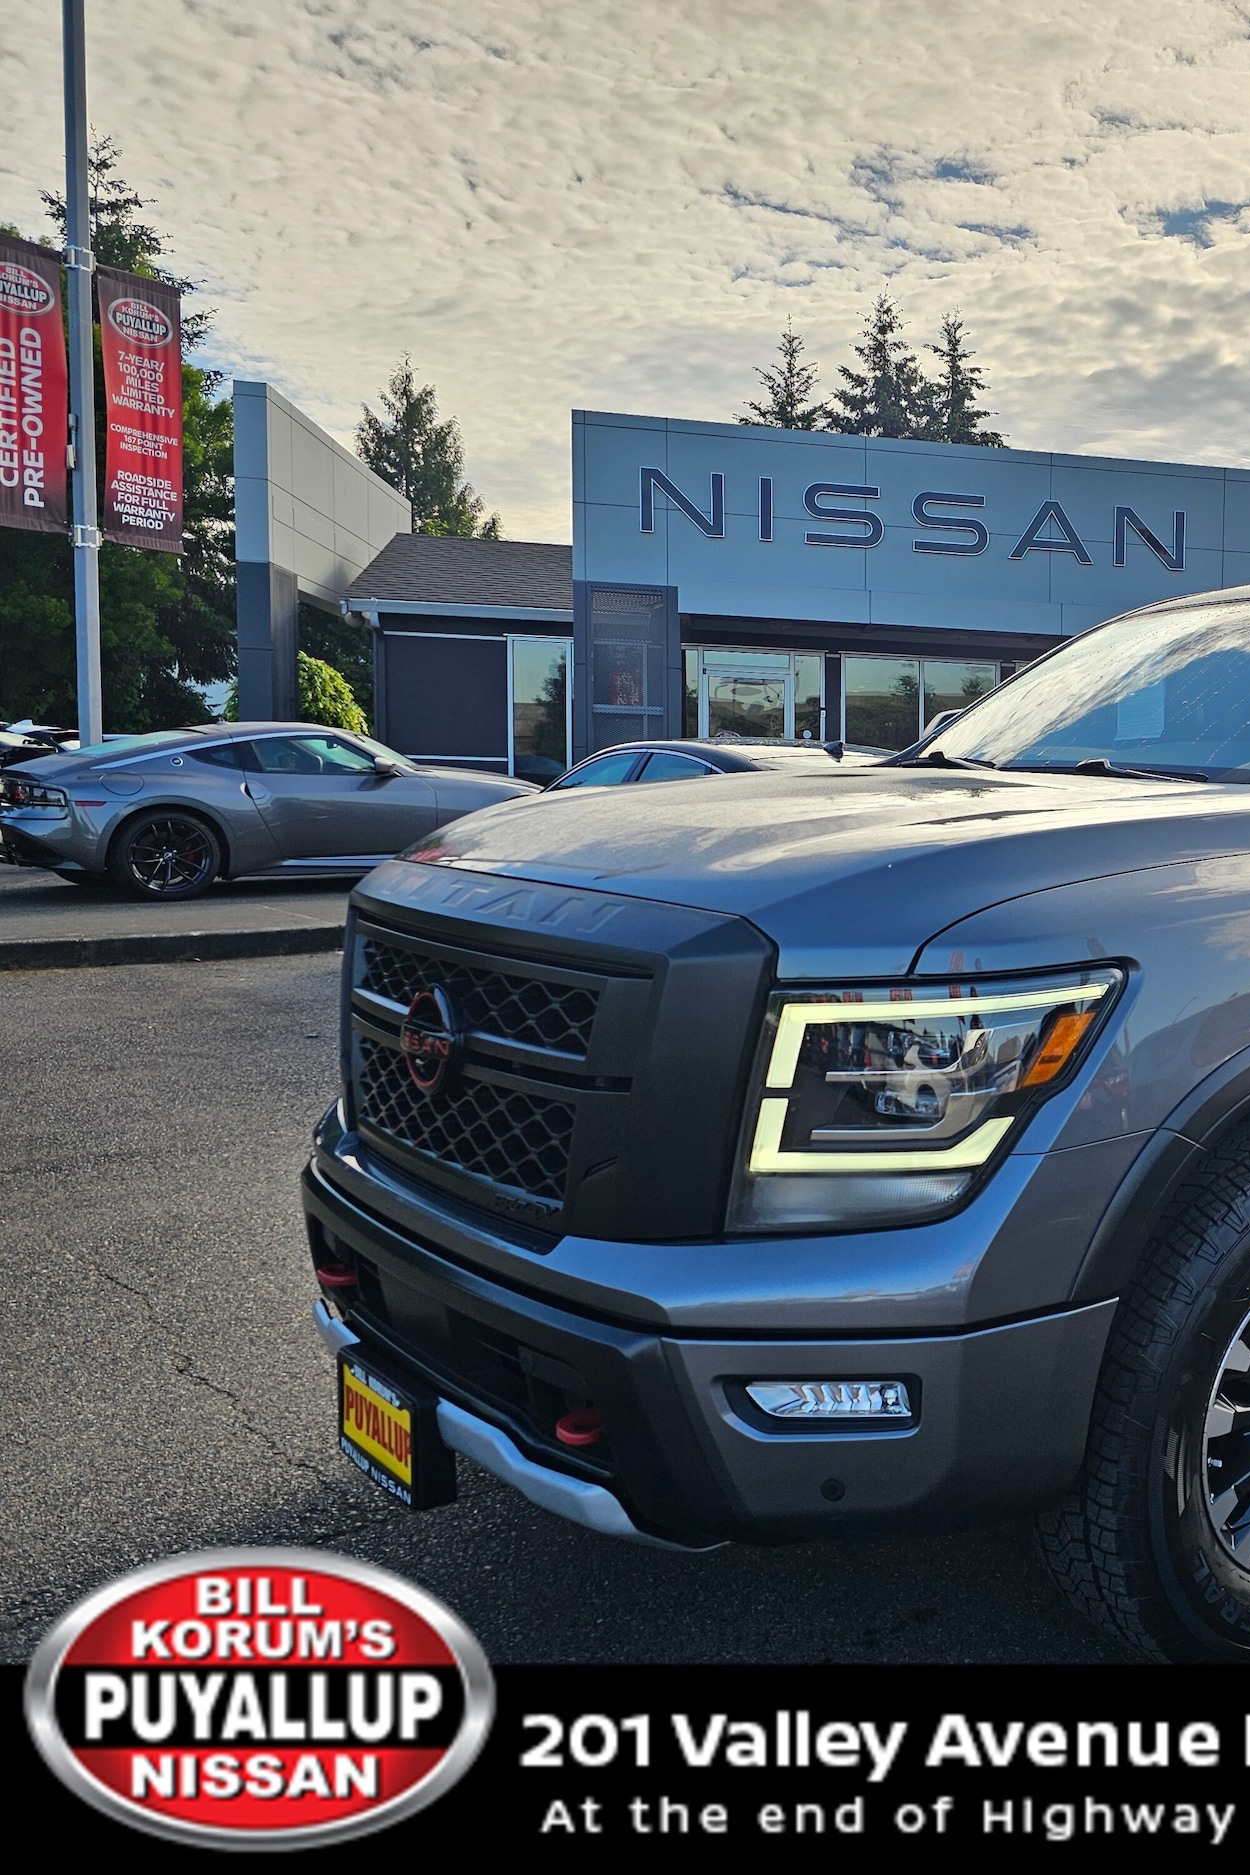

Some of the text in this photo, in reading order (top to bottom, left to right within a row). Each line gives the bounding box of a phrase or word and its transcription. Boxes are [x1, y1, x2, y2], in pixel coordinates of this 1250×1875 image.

[0, 272, 39, 288] ORUM'S
[5, 266, 27, 278] BILL
[122, 306, 160, 322] KORUM'S
[131, 302, 149, 313] BILL
[116, 312, 167, 336] PUYALLUP
[123, 326, 158, 343] NISSAN
[118, 351, 165, 373] 7-YEAR/
[117, 362, 164, 383] 100,000
[126, 375, 160, 393] MILES
[121, 385, 165, 405] LIMITED
[112, 393, 175, 418] WARRANTY
[20, 327, 45, 508] PRE-OWNED
[110, 423, 179, 446] COMPREHENSIVE
[124, 435, 164, 451] 167 POINT
[120, 442, 168, 459] INSPECTION
[117, 470, 172, 490] ROADSIDE
[111, 480, 178, 501] ASSISTANCE
[118, 492, 169, 511] FOR FULL
[113, 502, 176, 522] WARRANTY
[638, 465, 1187, 572] NISSAN
[122, 515, 164, 530] PERIOD
[380, 866, 627, 934] TITAN
[345, 1384, 411, 1468] PUYALLUP
[371, 1466, 411, 1506] NISSAN
